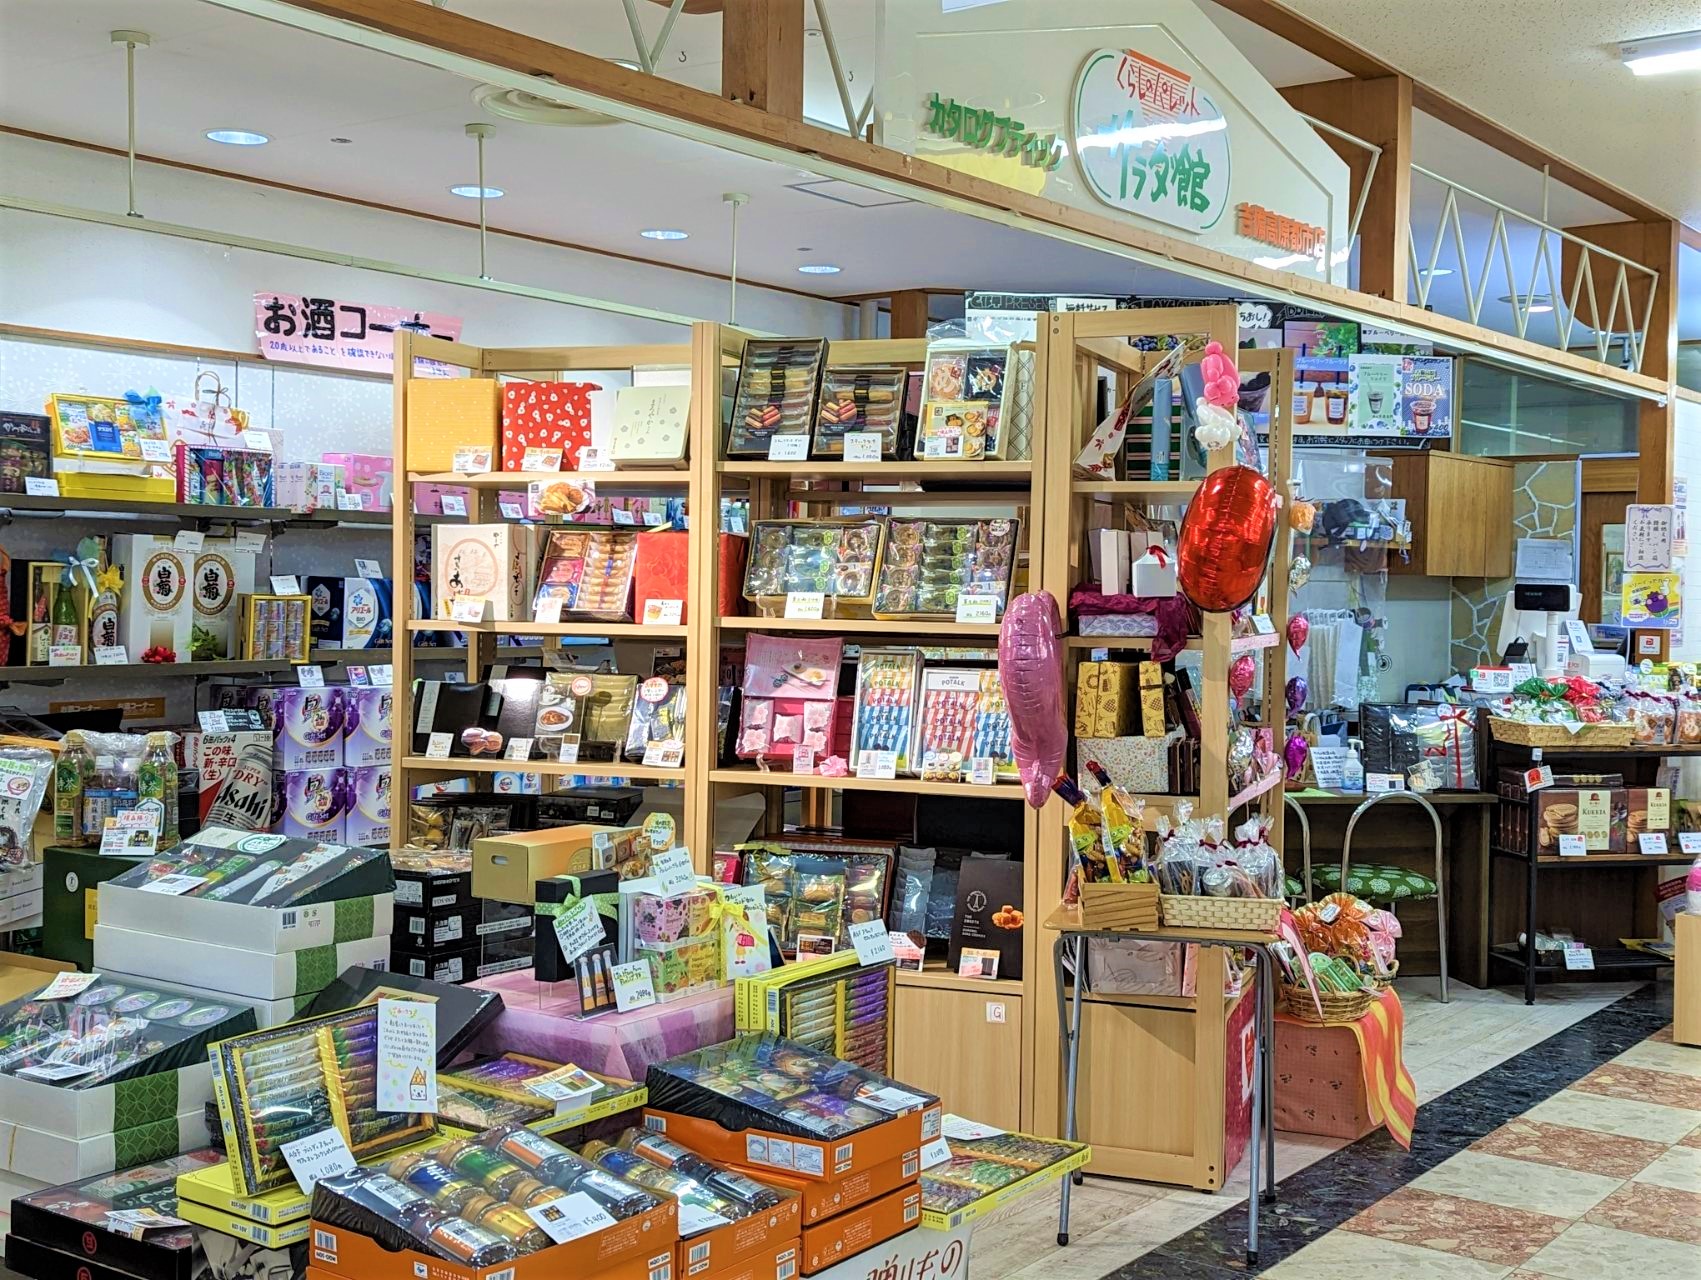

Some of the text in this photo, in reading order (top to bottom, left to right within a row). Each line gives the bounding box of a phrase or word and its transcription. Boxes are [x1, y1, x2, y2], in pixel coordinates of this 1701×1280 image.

[1117, 56, 1201, 117] くらしのパレット
[1404, 384, 1444, 397] SODA
[156, 565, 173, 598] 白菊
[203, 569, 221, 601] 白菊
[350, 606, 372, 614] アリエール
[874, 679, 900, 687] POTALK
[942, 679, 965, 687] POTALK
[935, 717, 961, 725] POTALK
[203, 745, 235, 757] この味、
[203, 757, 238, 769] 新・辛口
[233, 769, 264, 787] DRY
[215, 781, 268, 822] Asahi
[222, 812, 237, 825] 生
[995, 1007, 1002, 1018] G
